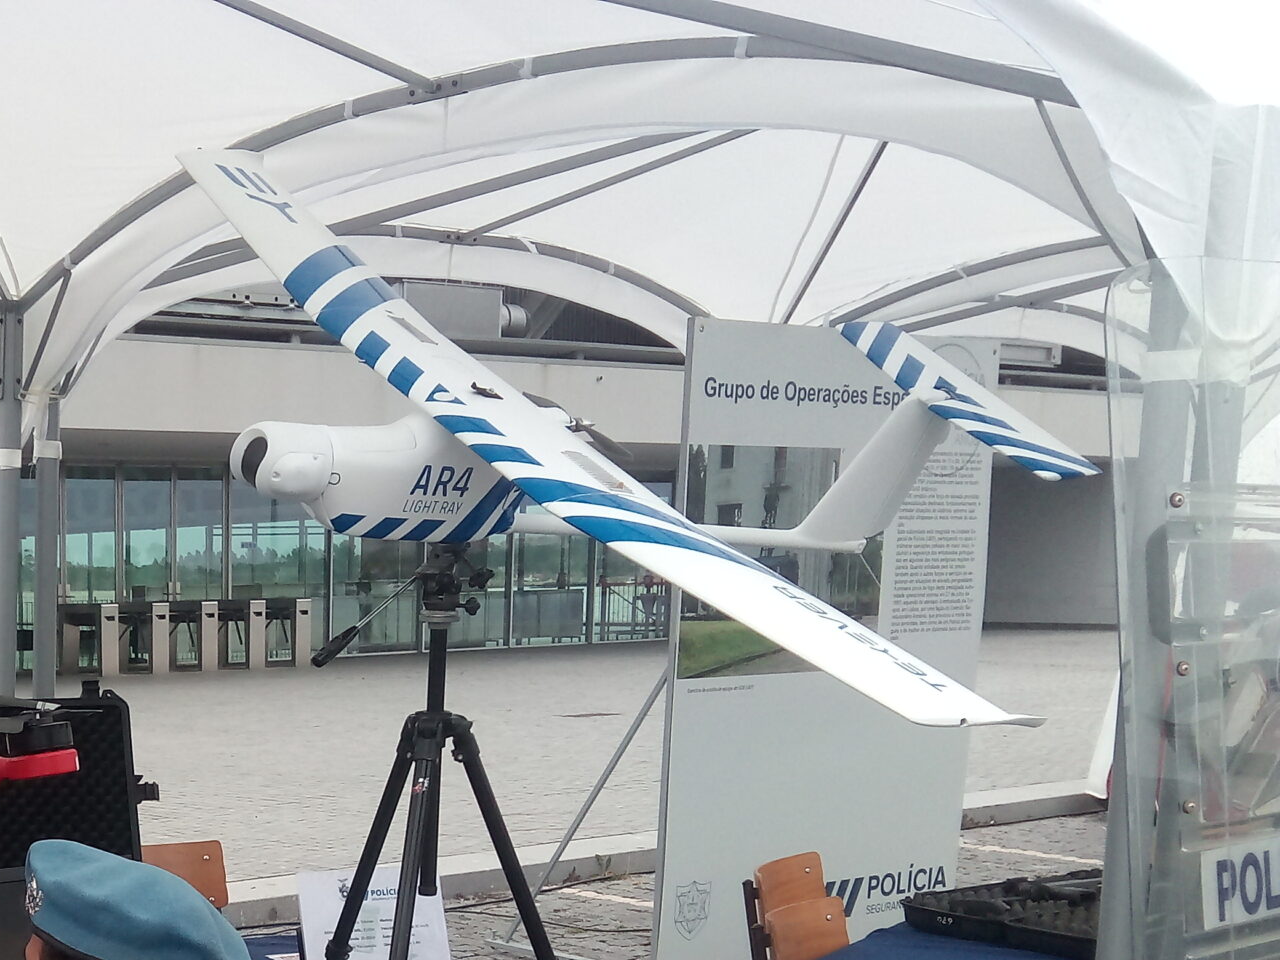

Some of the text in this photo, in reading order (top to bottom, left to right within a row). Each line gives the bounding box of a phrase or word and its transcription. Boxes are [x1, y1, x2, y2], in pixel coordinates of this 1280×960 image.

[704, 377, 756, 402] Grupo
[760, 379, 780, 401] de
[784, 380, 868, 408] Operações
[410, 464, 474, 498] AR4
[370, 887, 398, 897] POLÍCI
[867, 863, 947, 899] POLÍCIA
[865, 900, 903, 915] SEGURAN
